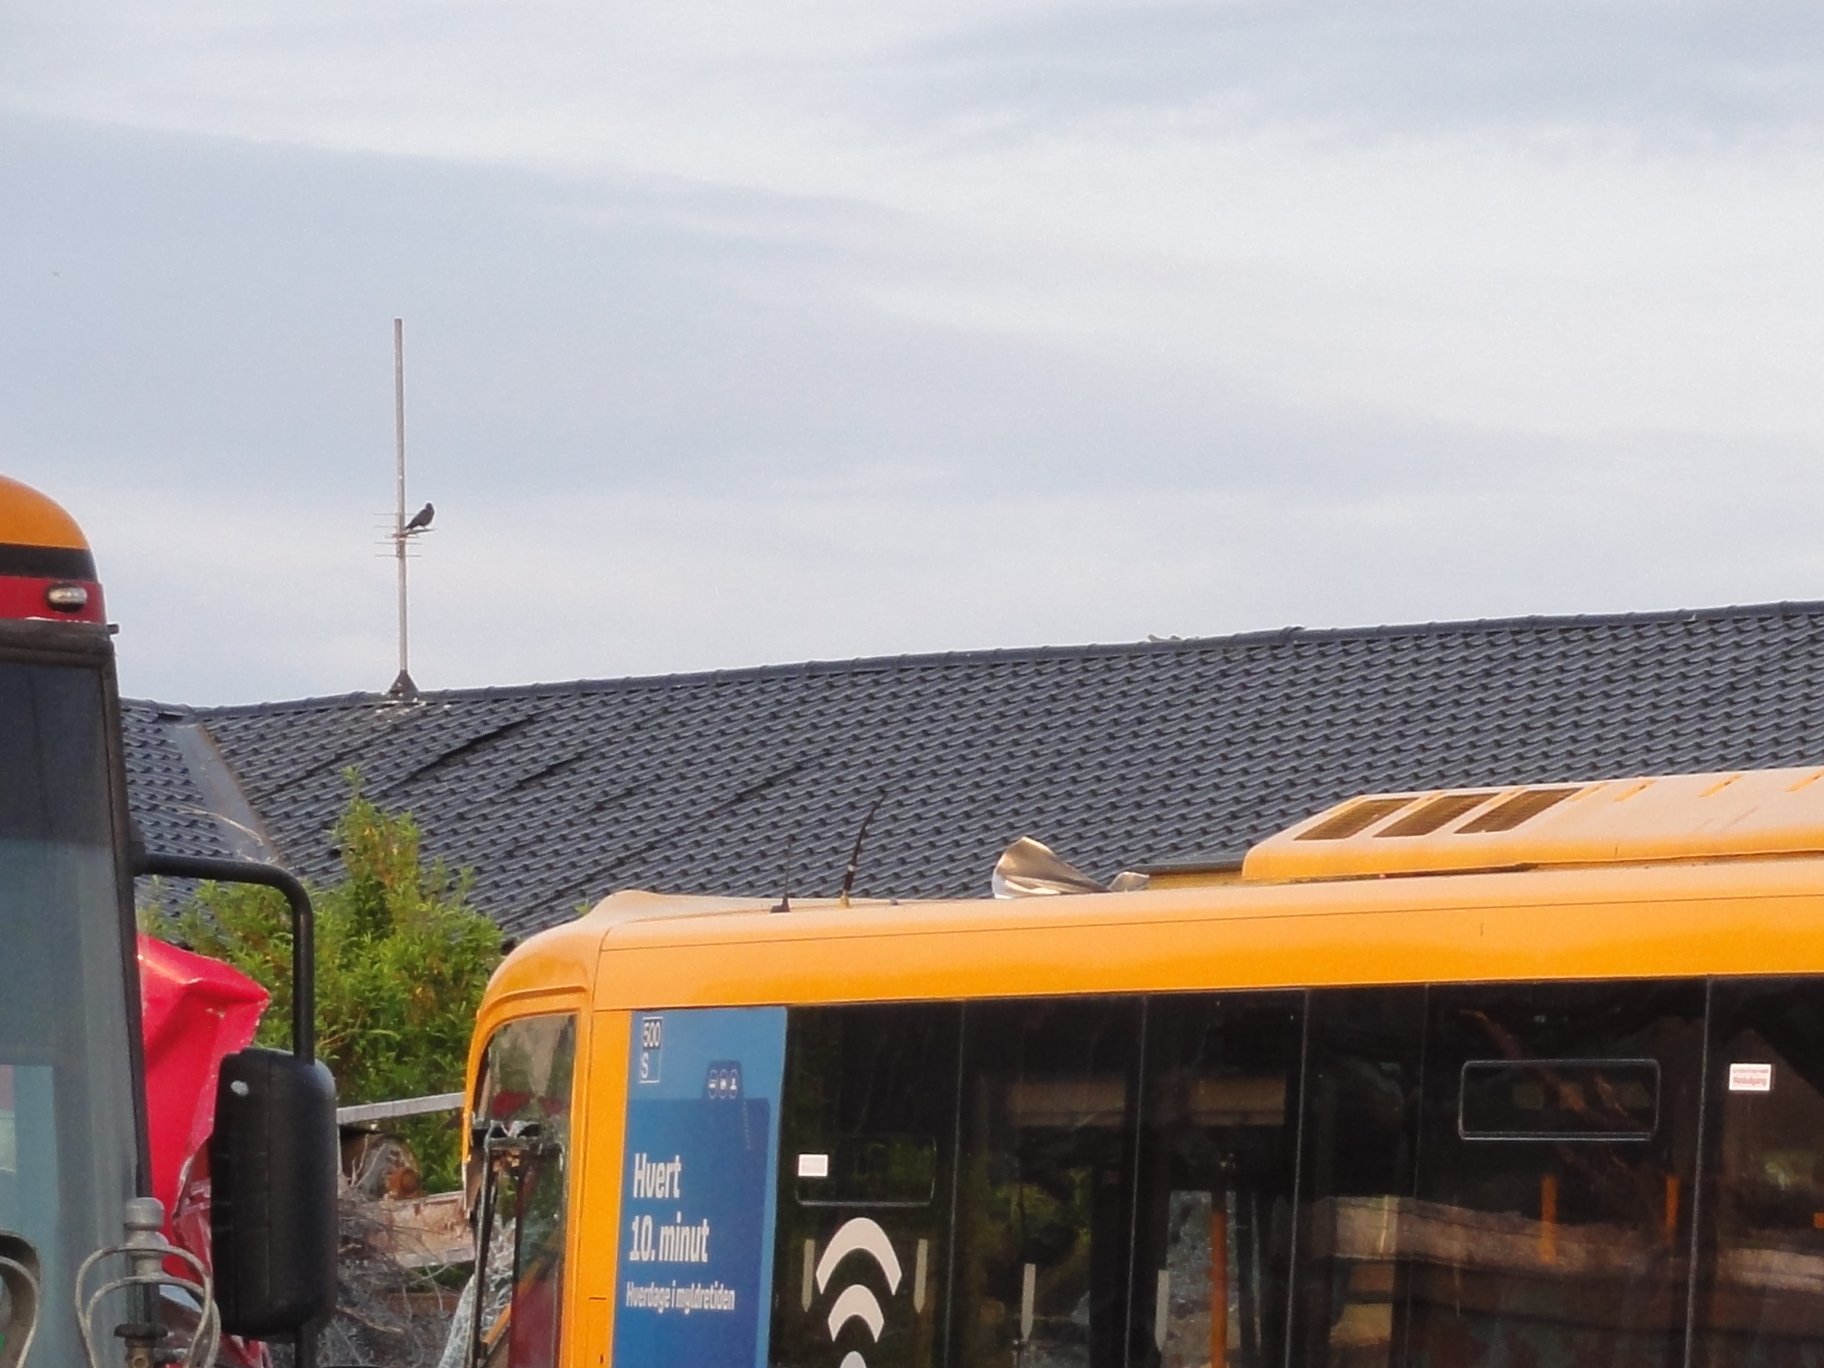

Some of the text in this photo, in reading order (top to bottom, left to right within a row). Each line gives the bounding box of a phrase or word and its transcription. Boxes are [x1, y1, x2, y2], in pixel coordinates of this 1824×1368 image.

[643, 1021, 661, 1048] 500
[640, 1052, 649, 1079] S
[633, 1152, 682, 1199] Hvert
[629, 1211, 710, 1263] 10. minut
[626, 1279, 736, 1315] Hverdage i myldretiden
